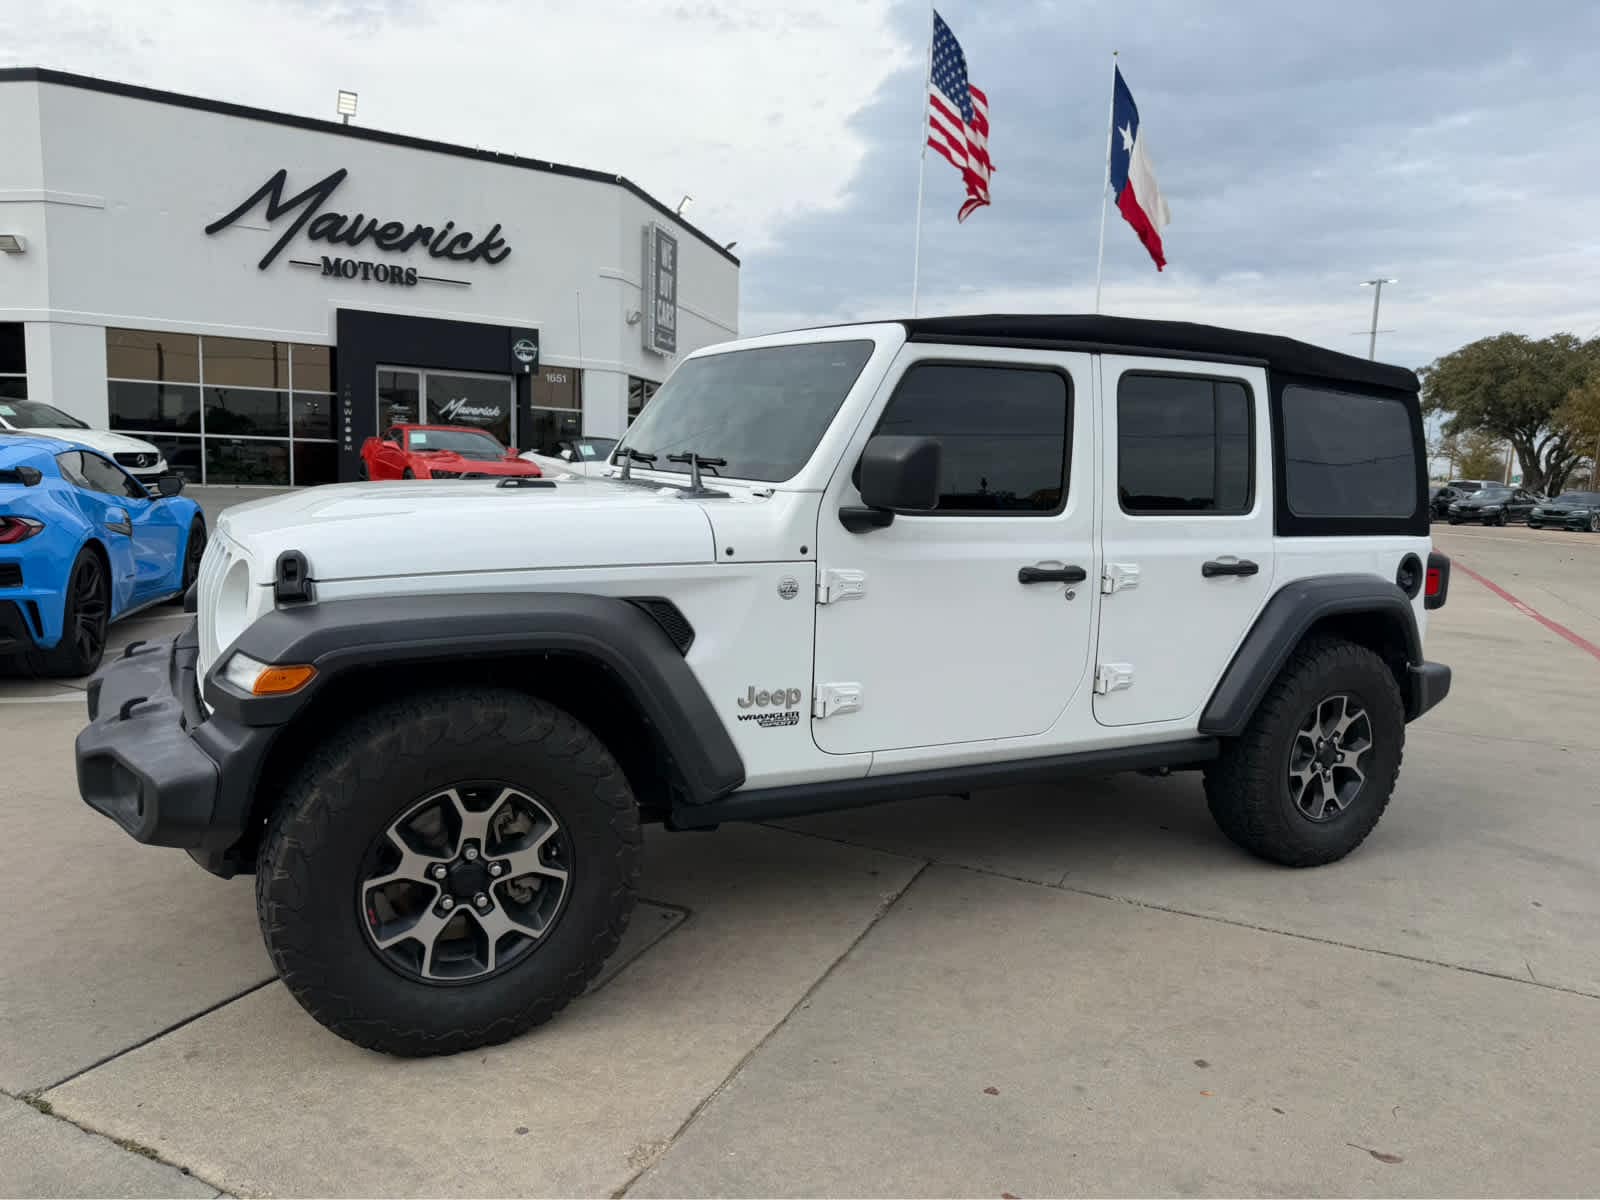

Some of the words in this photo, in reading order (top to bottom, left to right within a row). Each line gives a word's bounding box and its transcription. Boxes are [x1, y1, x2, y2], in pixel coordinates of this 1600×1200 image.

[204, 167, 512, 270] Maverick
[320, 256, 418, 286] MOTORS
[545, 372, 567, 384] 1651
[438, 396, 501, 420] Maverick
[738, 686, 801, 709] Jeep
[737, 711, 800, 721] WRANGLER
